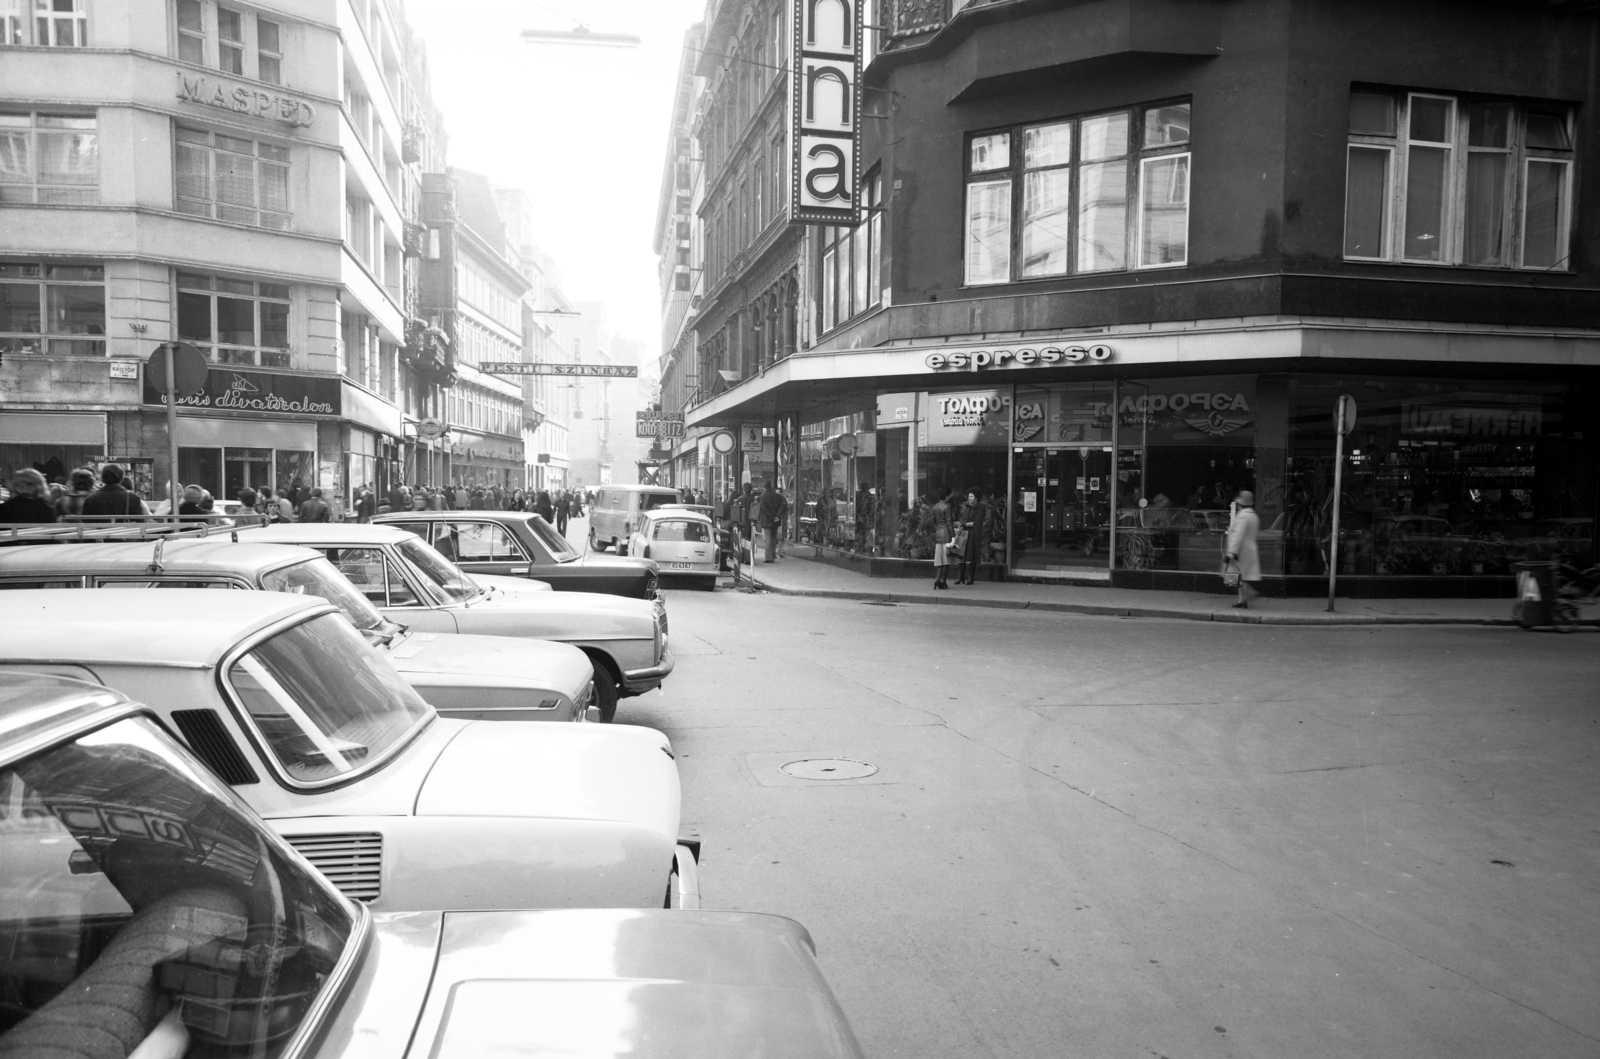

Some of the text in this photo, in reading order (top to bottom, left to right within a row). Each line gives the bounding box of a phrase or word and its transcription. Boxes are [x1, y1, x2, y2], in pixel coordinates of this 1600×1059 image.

[176, 71, 316, 127] MASPED
[480, 363, 537, 374] PESTI
[924, 344, 1114, 372] espresso
